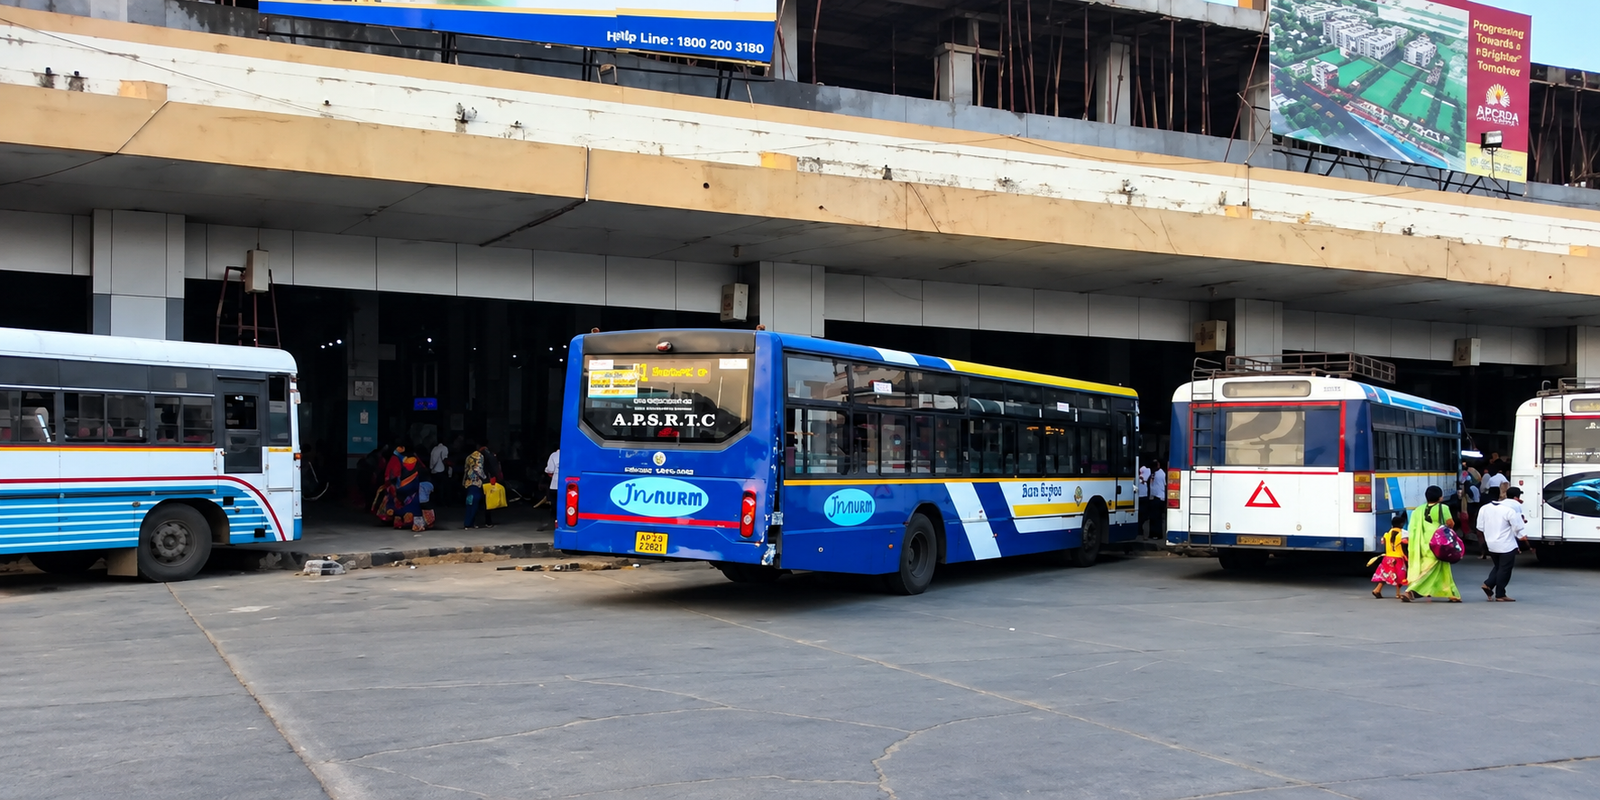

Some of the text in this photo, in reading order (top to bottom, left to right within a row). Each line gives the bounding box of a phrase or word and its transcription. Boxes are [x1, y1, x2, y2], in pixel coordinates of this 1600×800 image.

[640, 32, 674, 46] Line:
[677, 36, 707, 49] 1800
[709, 39, 733, 51] 200
[735, 42, 765, 54] 3180
[1475, 32, 1514, 50] Towards
[612, 413, 716, 427] A.P.S.R.T.C
